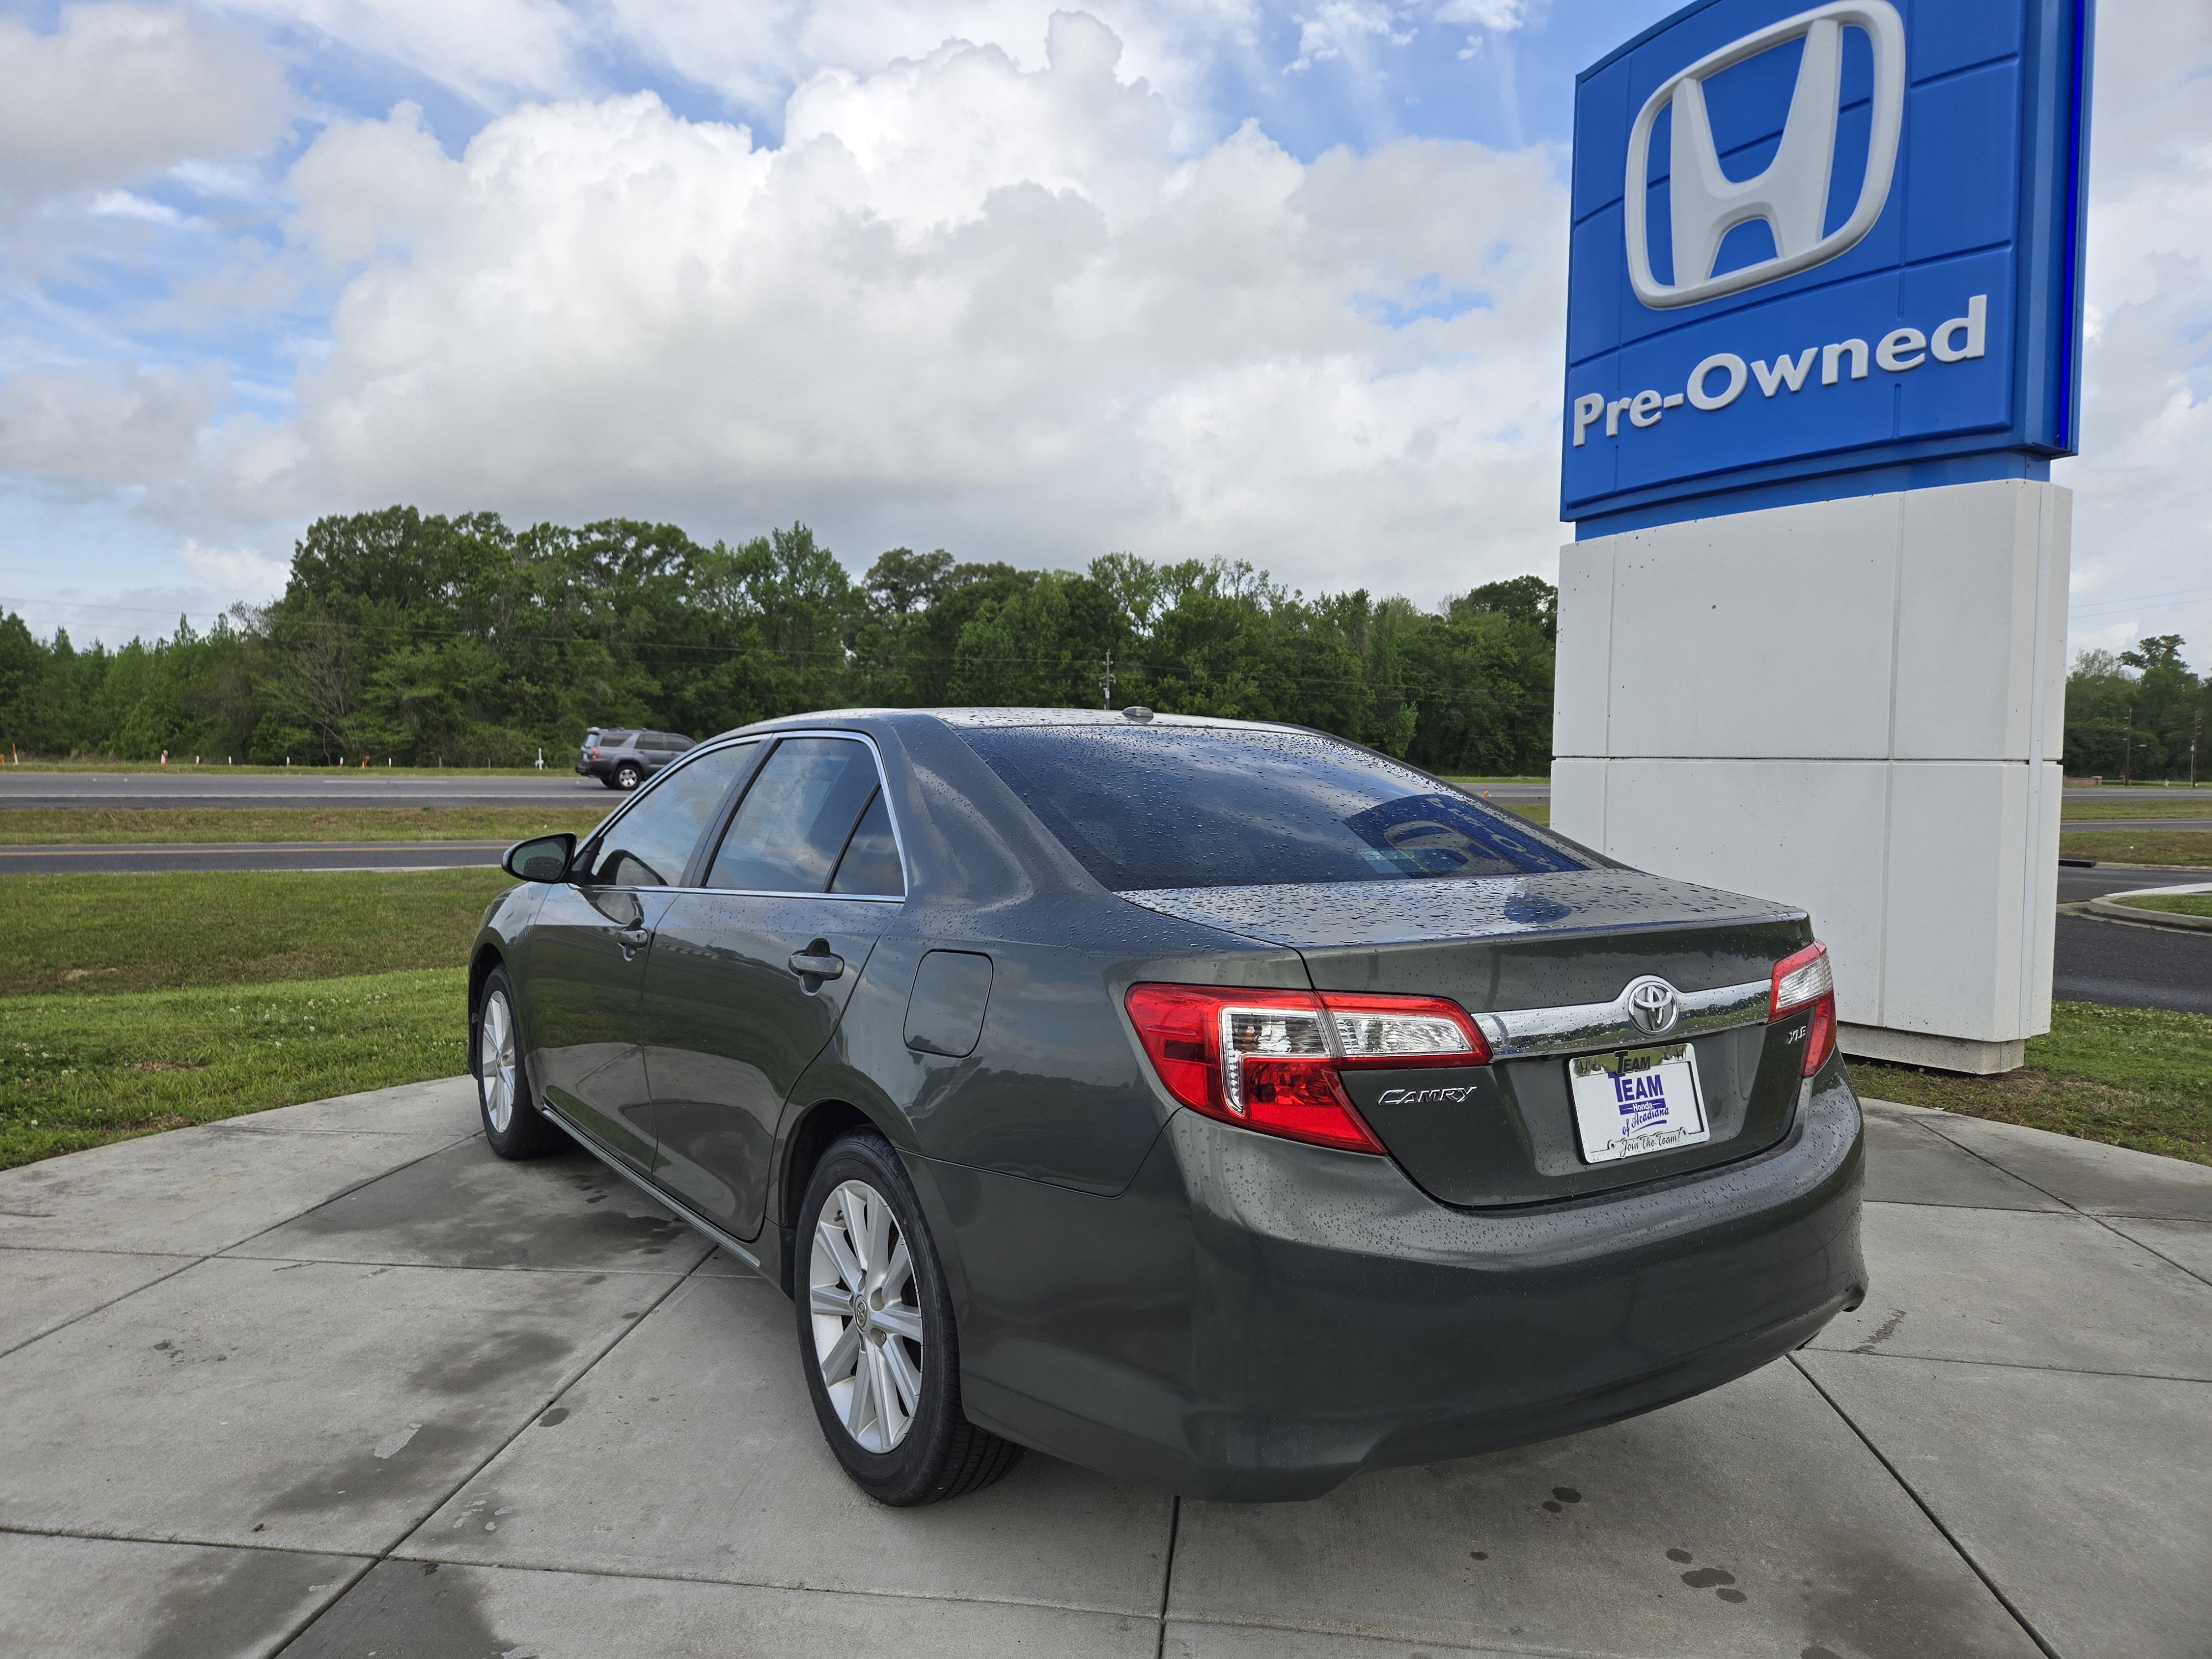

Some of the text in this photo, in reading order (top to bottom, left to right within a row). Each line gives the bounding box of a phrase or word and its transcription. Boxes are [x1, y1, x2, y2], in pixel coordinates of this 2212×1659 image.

[1573, 294, 1987, 446] Pre-Owned
[1615, 1050, 1651, 1073] TEAM
[1378, 1086, 1477, 1105] CAMRY
[1608, 1072, 1663, 1102] TEAM
[1632, 1102, 1652, 1112] Honda
[1623, 1107, 1669, 1137] of Acadiana
[1620, 1139, 1638, 1157] Join
[1640, 1136, 1655, 1149] The
